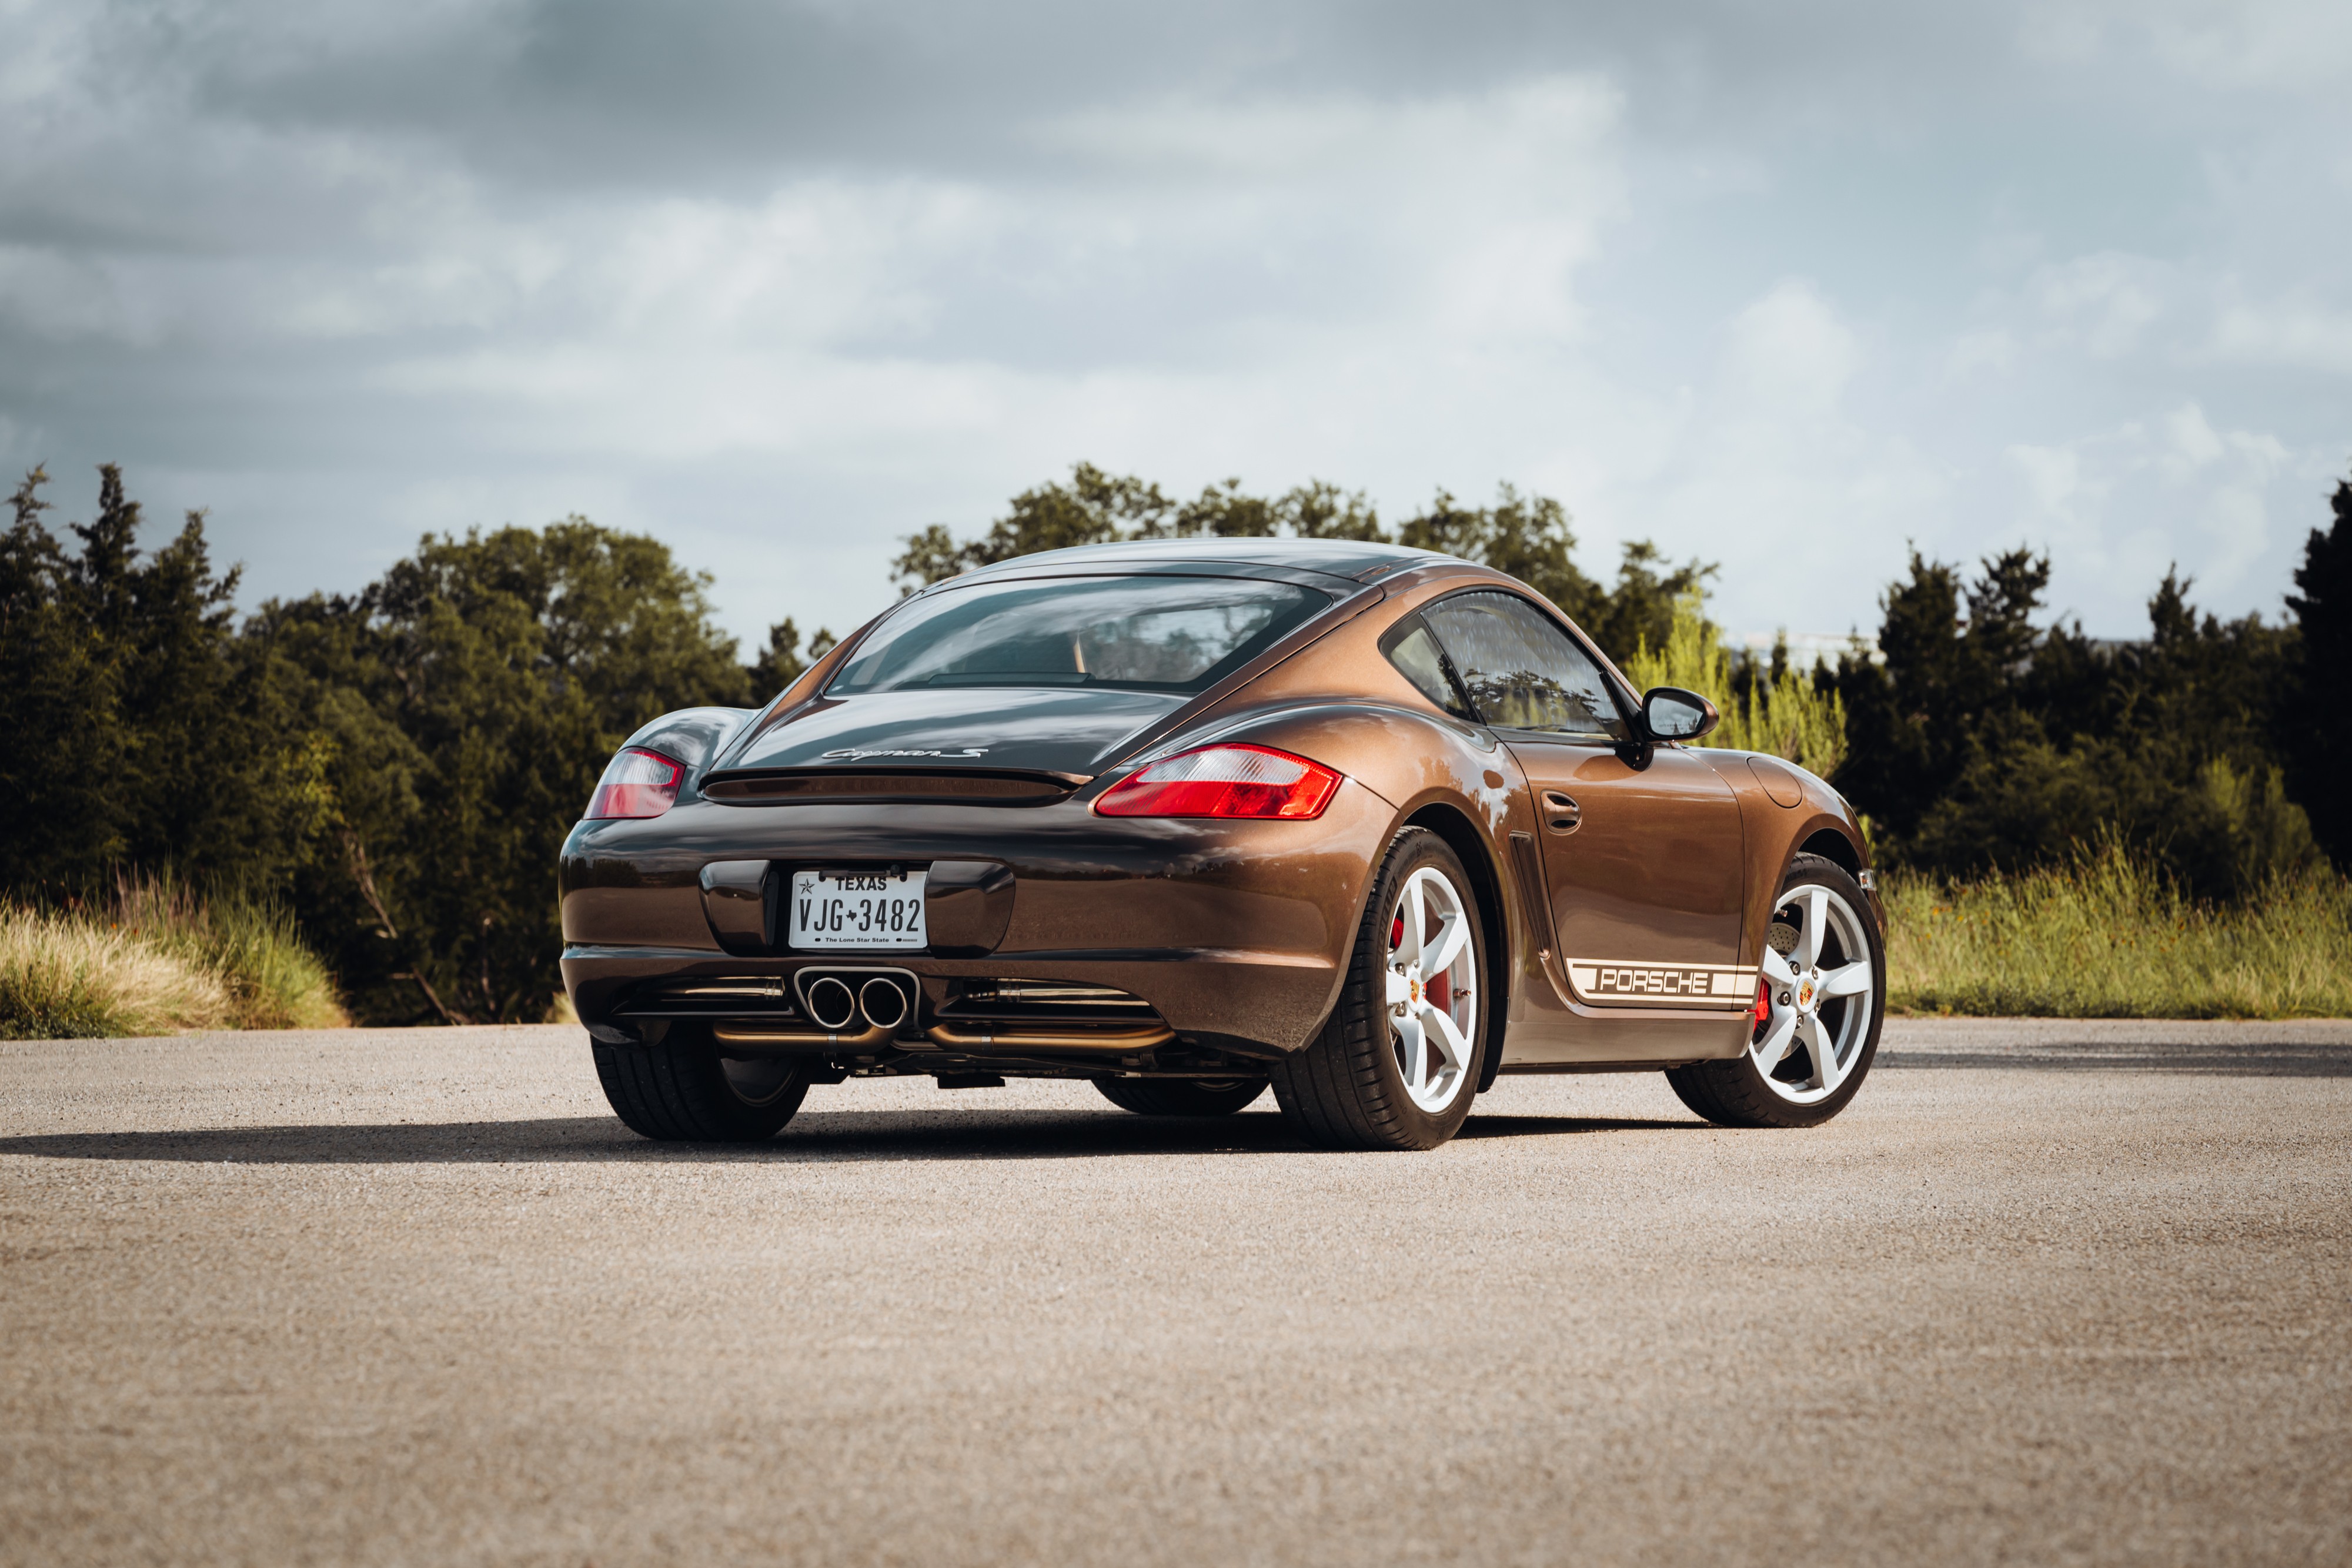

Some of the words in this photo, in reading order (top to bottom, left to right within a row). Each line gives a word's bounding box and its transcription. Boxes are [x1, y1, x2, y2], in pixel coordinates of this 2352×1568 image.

[821, 748, 941, 762] Cayman
[940, 748, 989, 758] S
[835, 877, 887, 891] TEXAS
[1377, 879, 1397, 972] MICHELIN
[1600, 968, 1709, 994] PORSCHE
